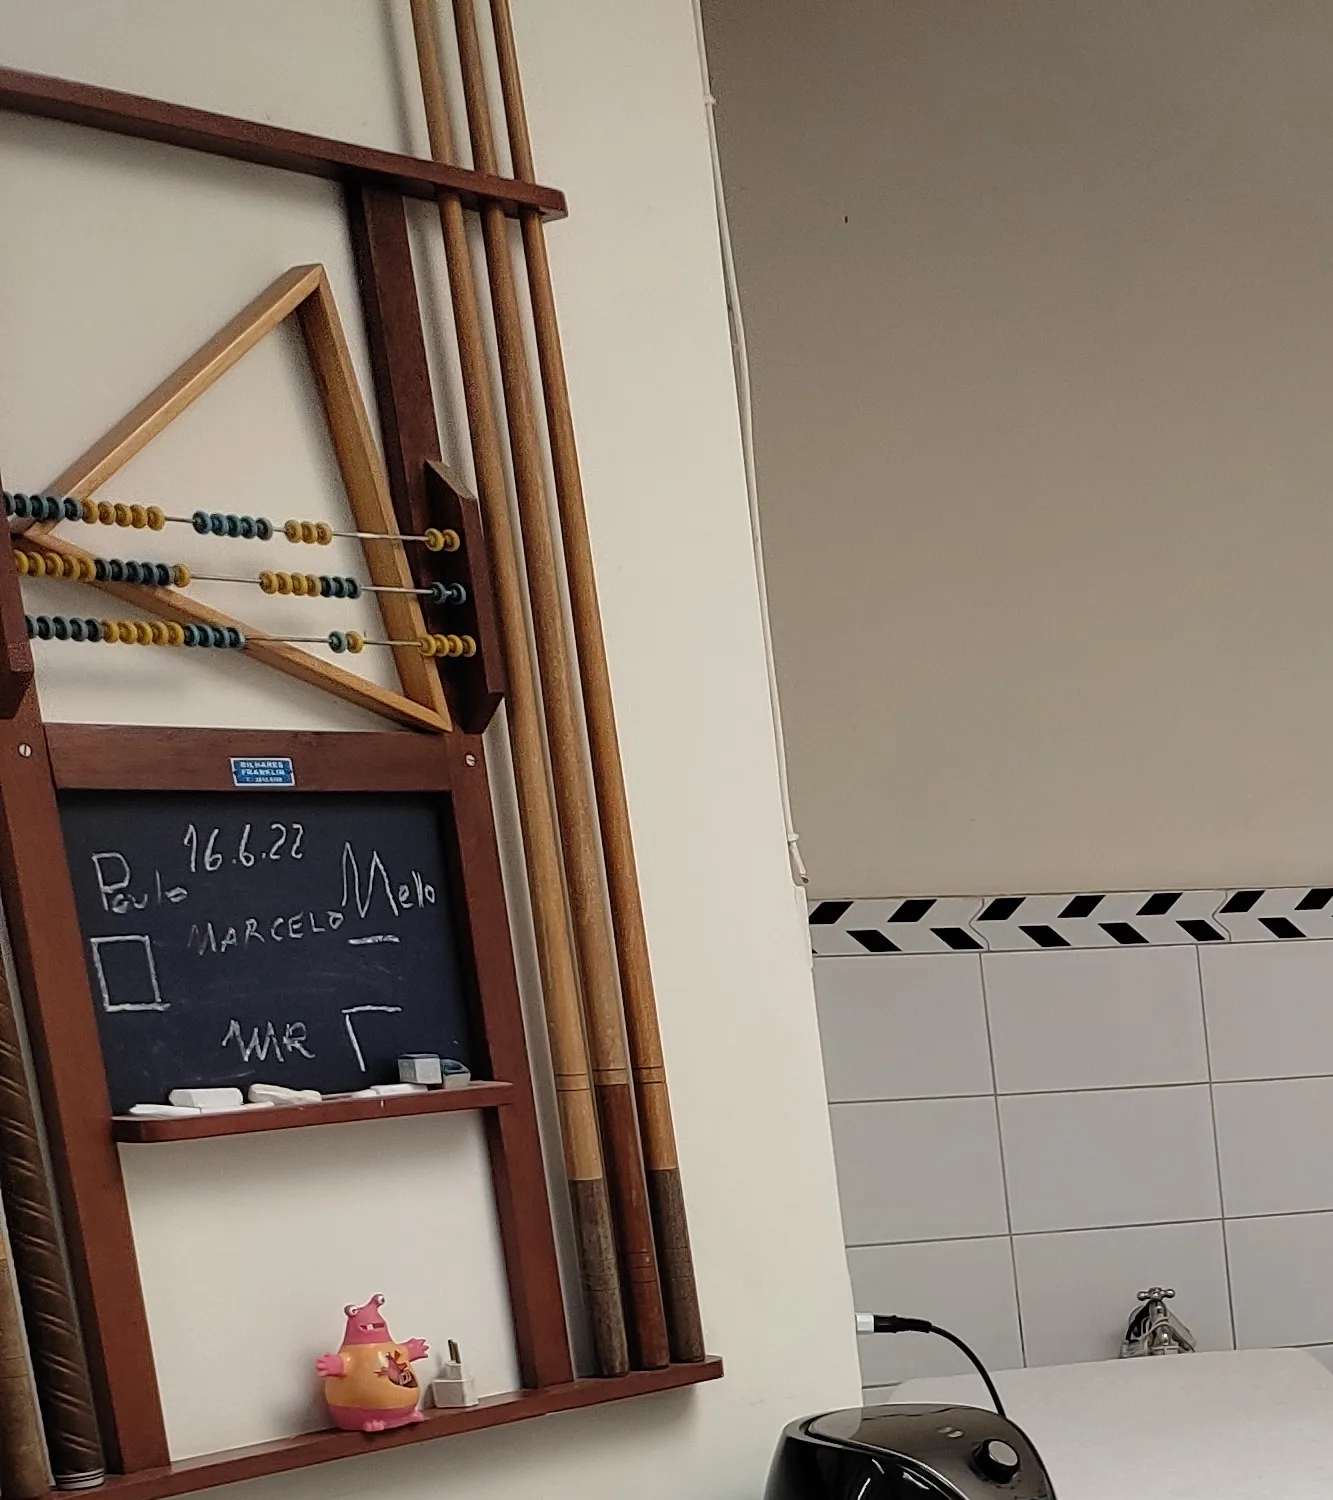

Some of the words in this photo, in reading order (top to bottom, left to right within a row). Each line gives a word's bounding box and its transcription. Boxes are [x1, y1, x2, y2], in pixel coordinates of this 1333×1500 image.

[184, 823, 304, 872] 16.6.22
[92, 852, 188, 913] Paulo
[187, 910, 344, 955] MARCELO
